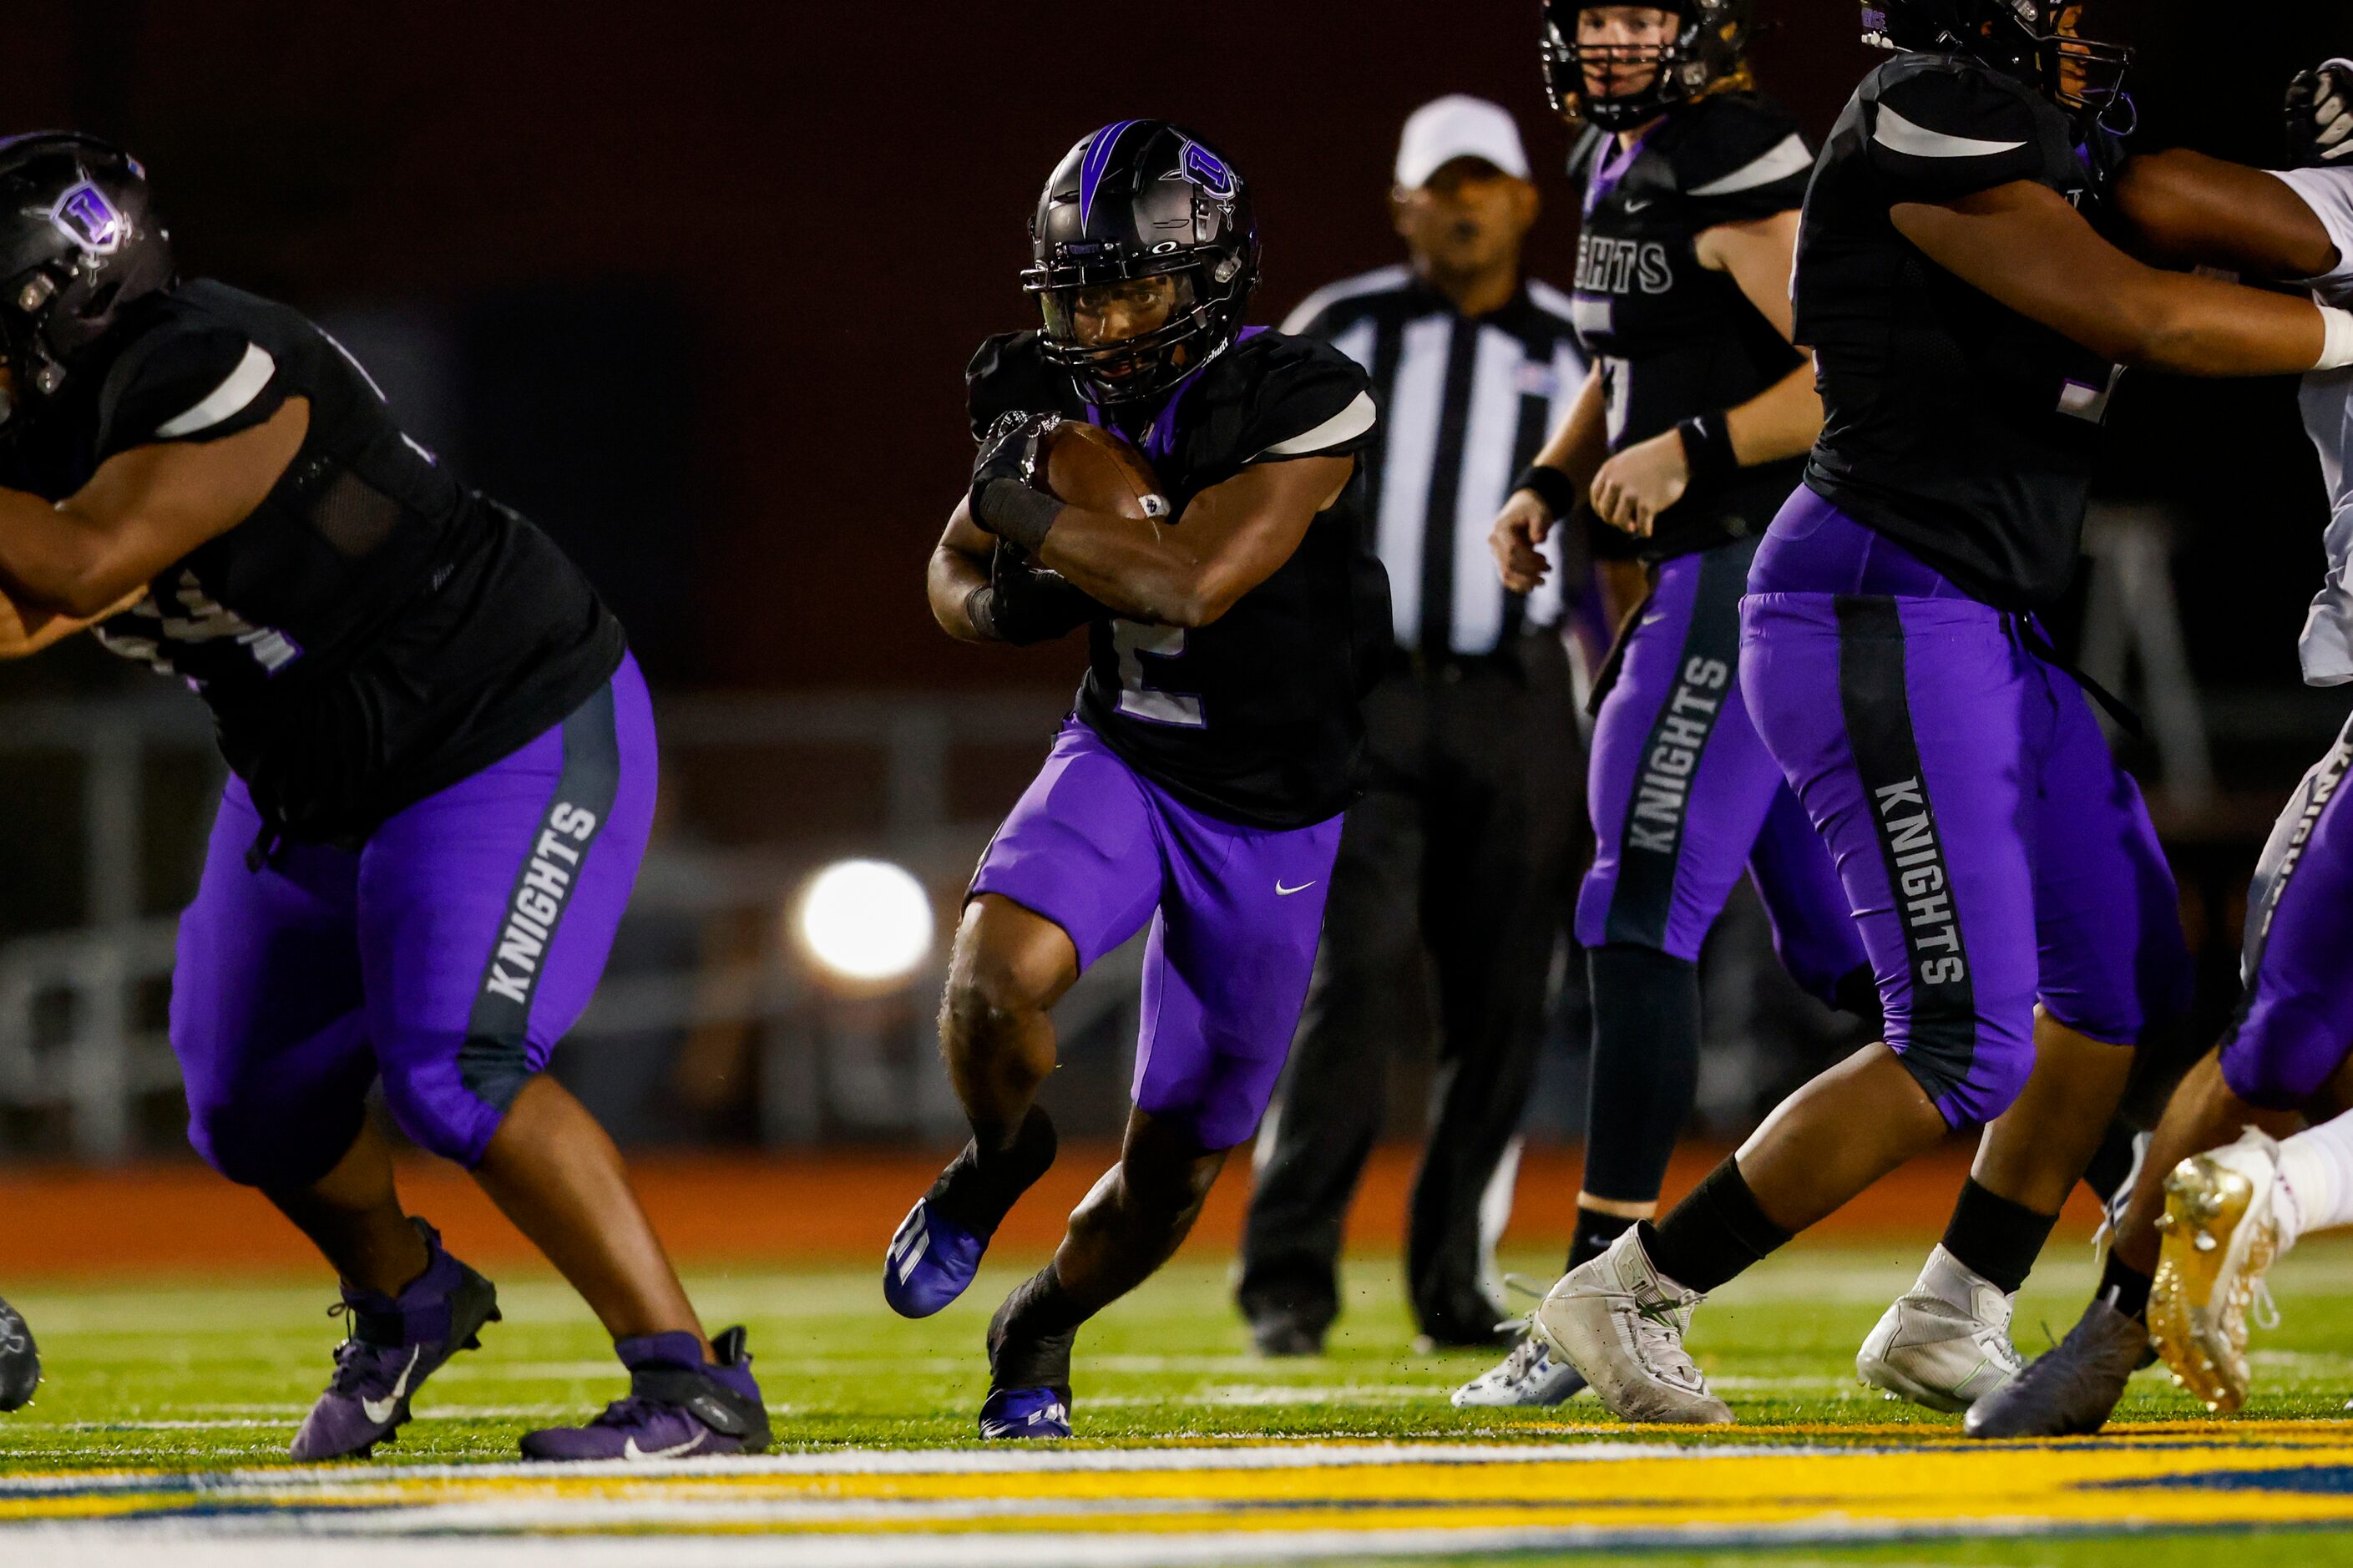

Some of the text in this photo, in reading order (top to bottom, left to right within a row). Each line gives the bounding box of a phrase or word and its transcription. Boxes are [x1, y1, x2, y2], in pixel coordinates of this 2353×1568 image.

[1629, 655, 1728, 855] KNIGHTS
[486, 801, 597, 1005] KNIGHTS
[1874, 776, 1965, 985] KNIGHTS
